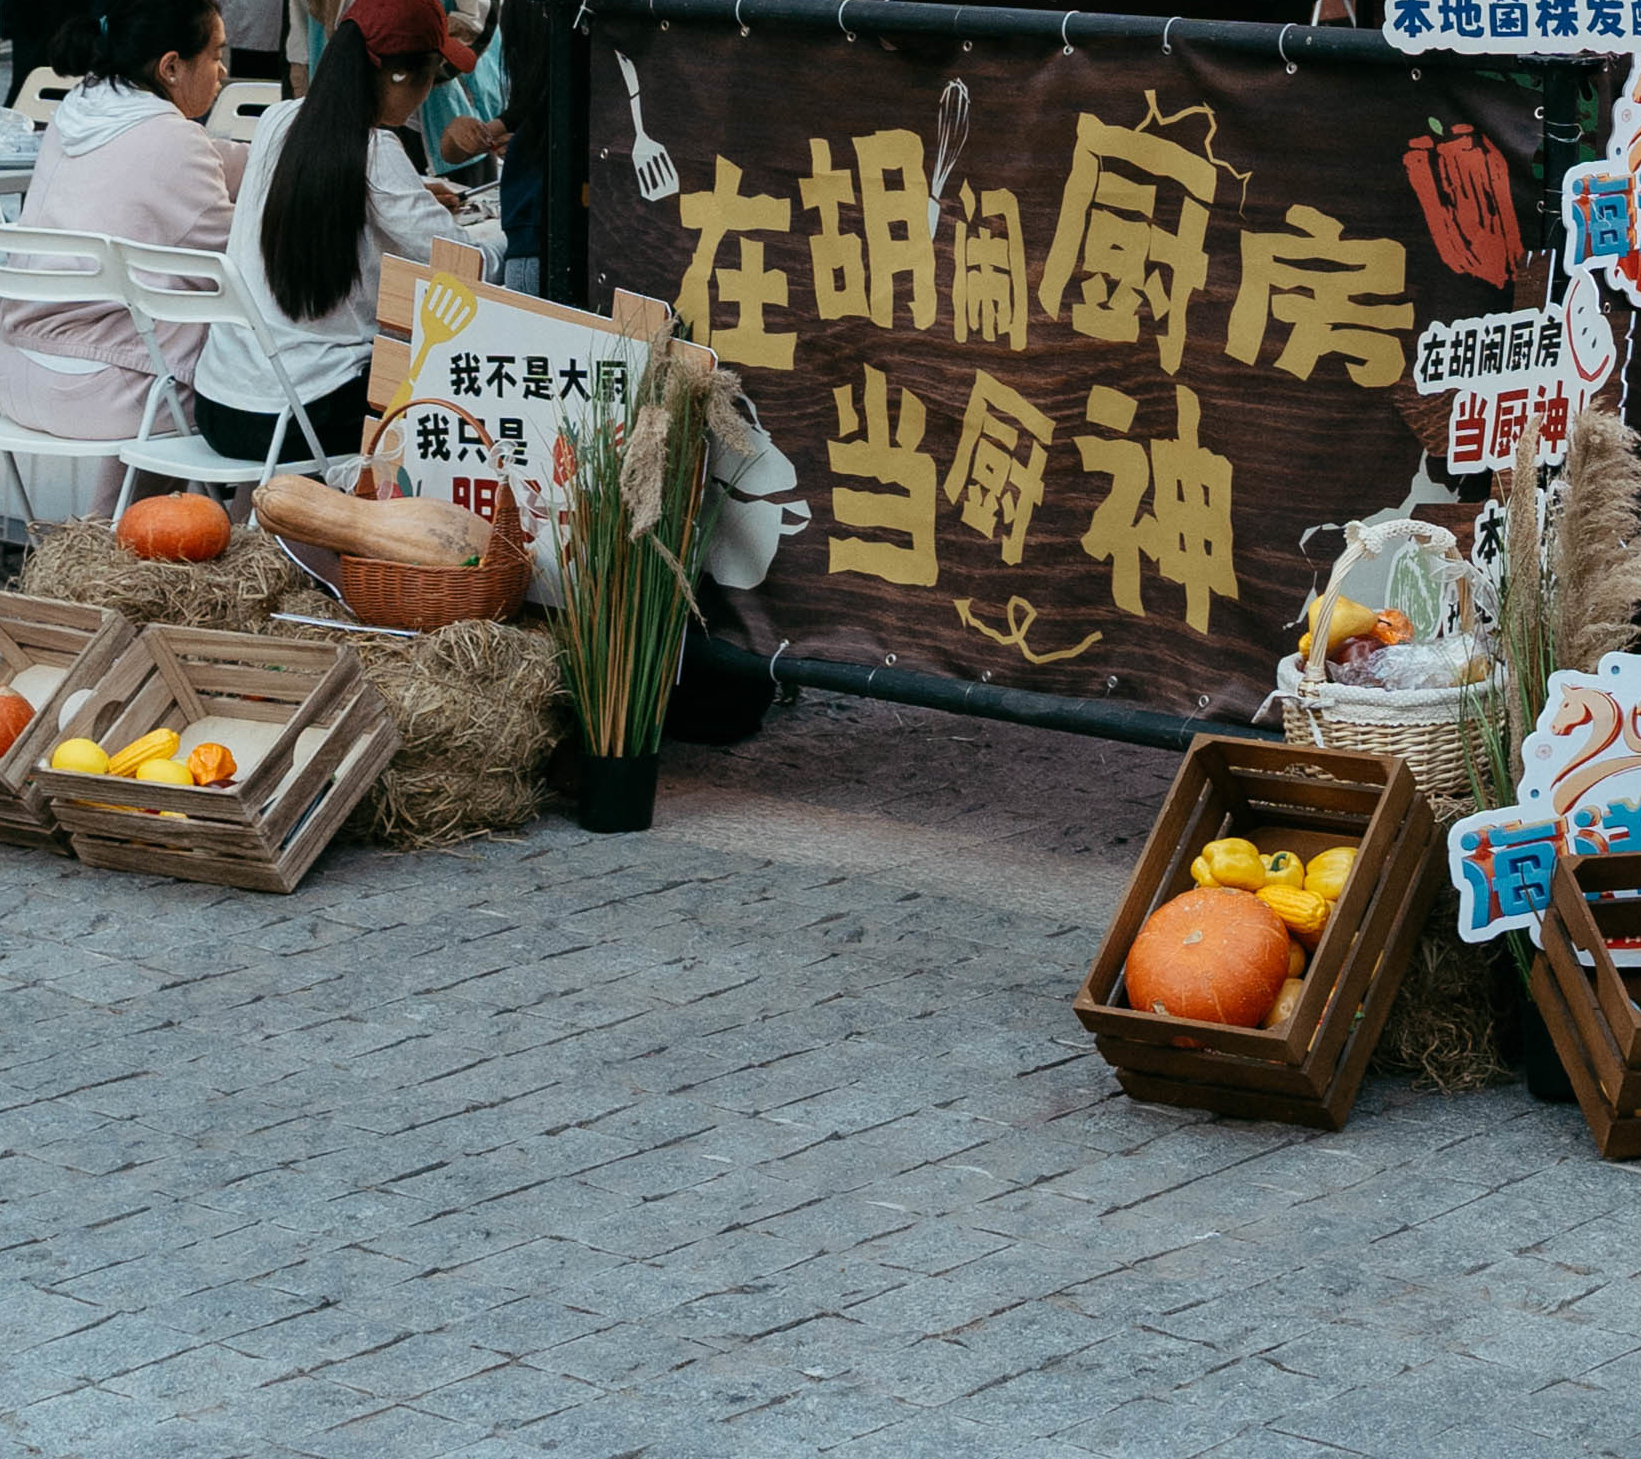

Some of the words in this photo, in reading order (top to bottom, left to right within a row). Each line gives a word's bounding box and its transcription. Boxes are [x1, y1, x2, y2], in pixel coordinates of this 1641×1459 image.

[677, 113, 1415, 389] 在胡闹厨房
[450, 352, 628, 404] 我不是大厨
[1420, 315, 1563, 383] 在胡闹厨房
[417, 414, 527, 466] 我只是
[827, 364, 1239, 635] 当厨神
